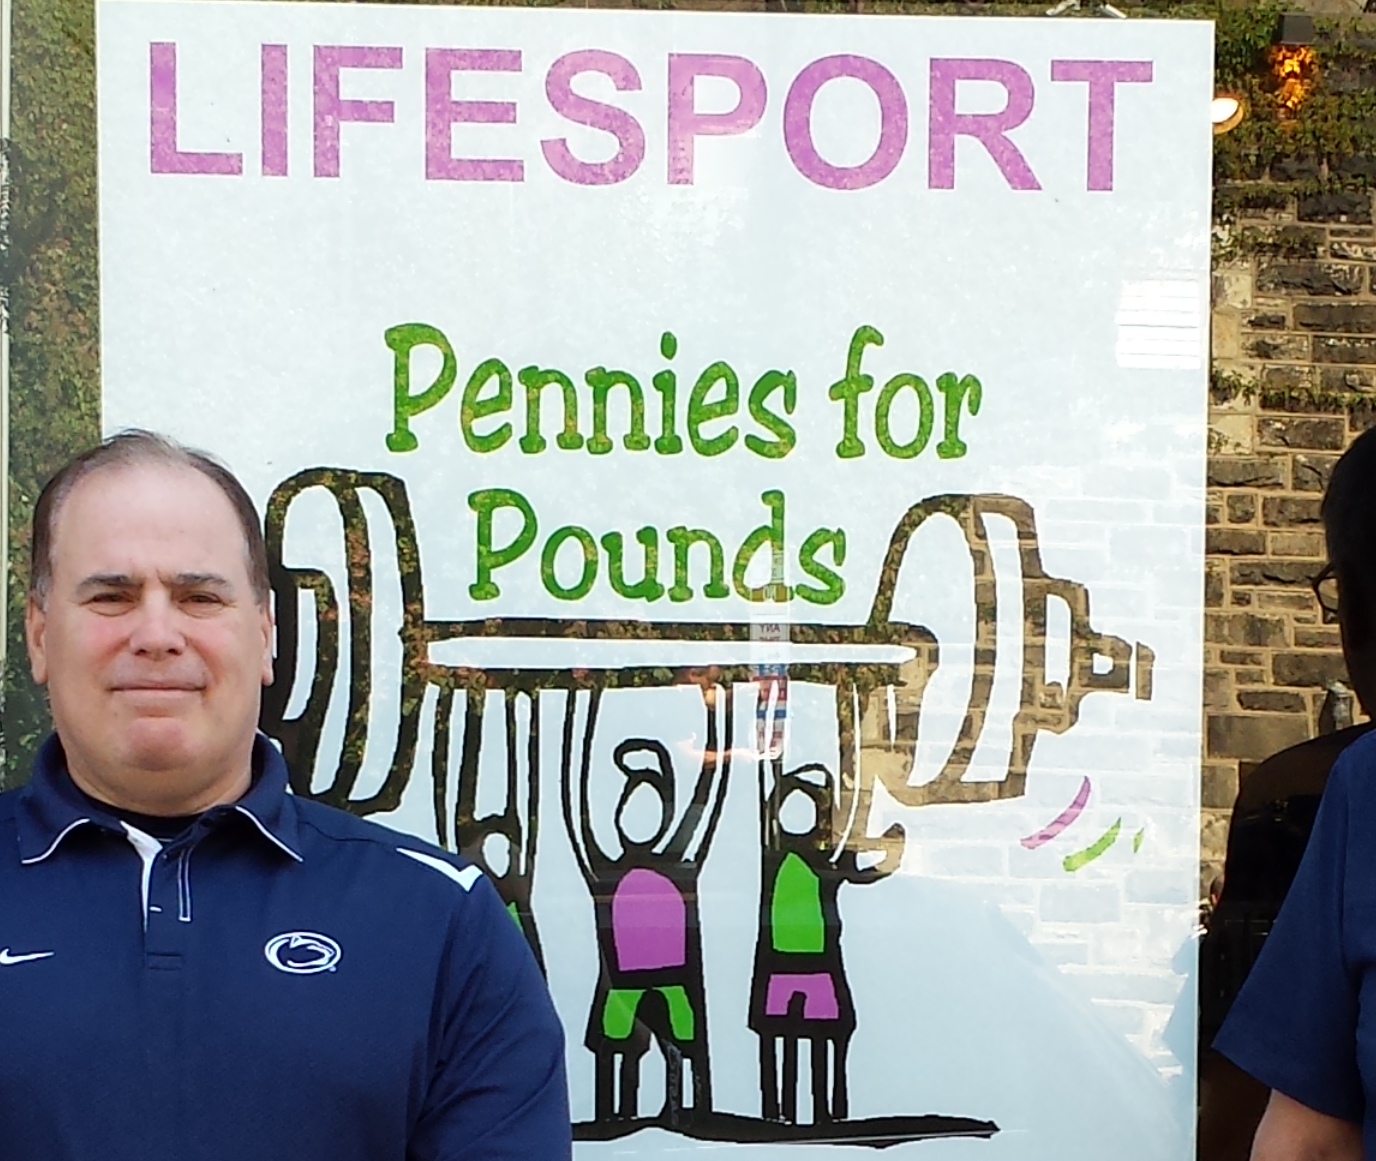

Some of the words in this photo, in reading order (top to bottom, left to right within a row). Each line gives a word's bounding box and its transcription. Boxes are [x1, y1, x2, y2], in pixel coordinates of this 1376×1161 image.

[150, 43, 1153, 191] LIFESPORT
[384, 323, 797, 459] Pennies
[828, 325, 982, 460] for
[467, 488, 846, 605] Pounds
